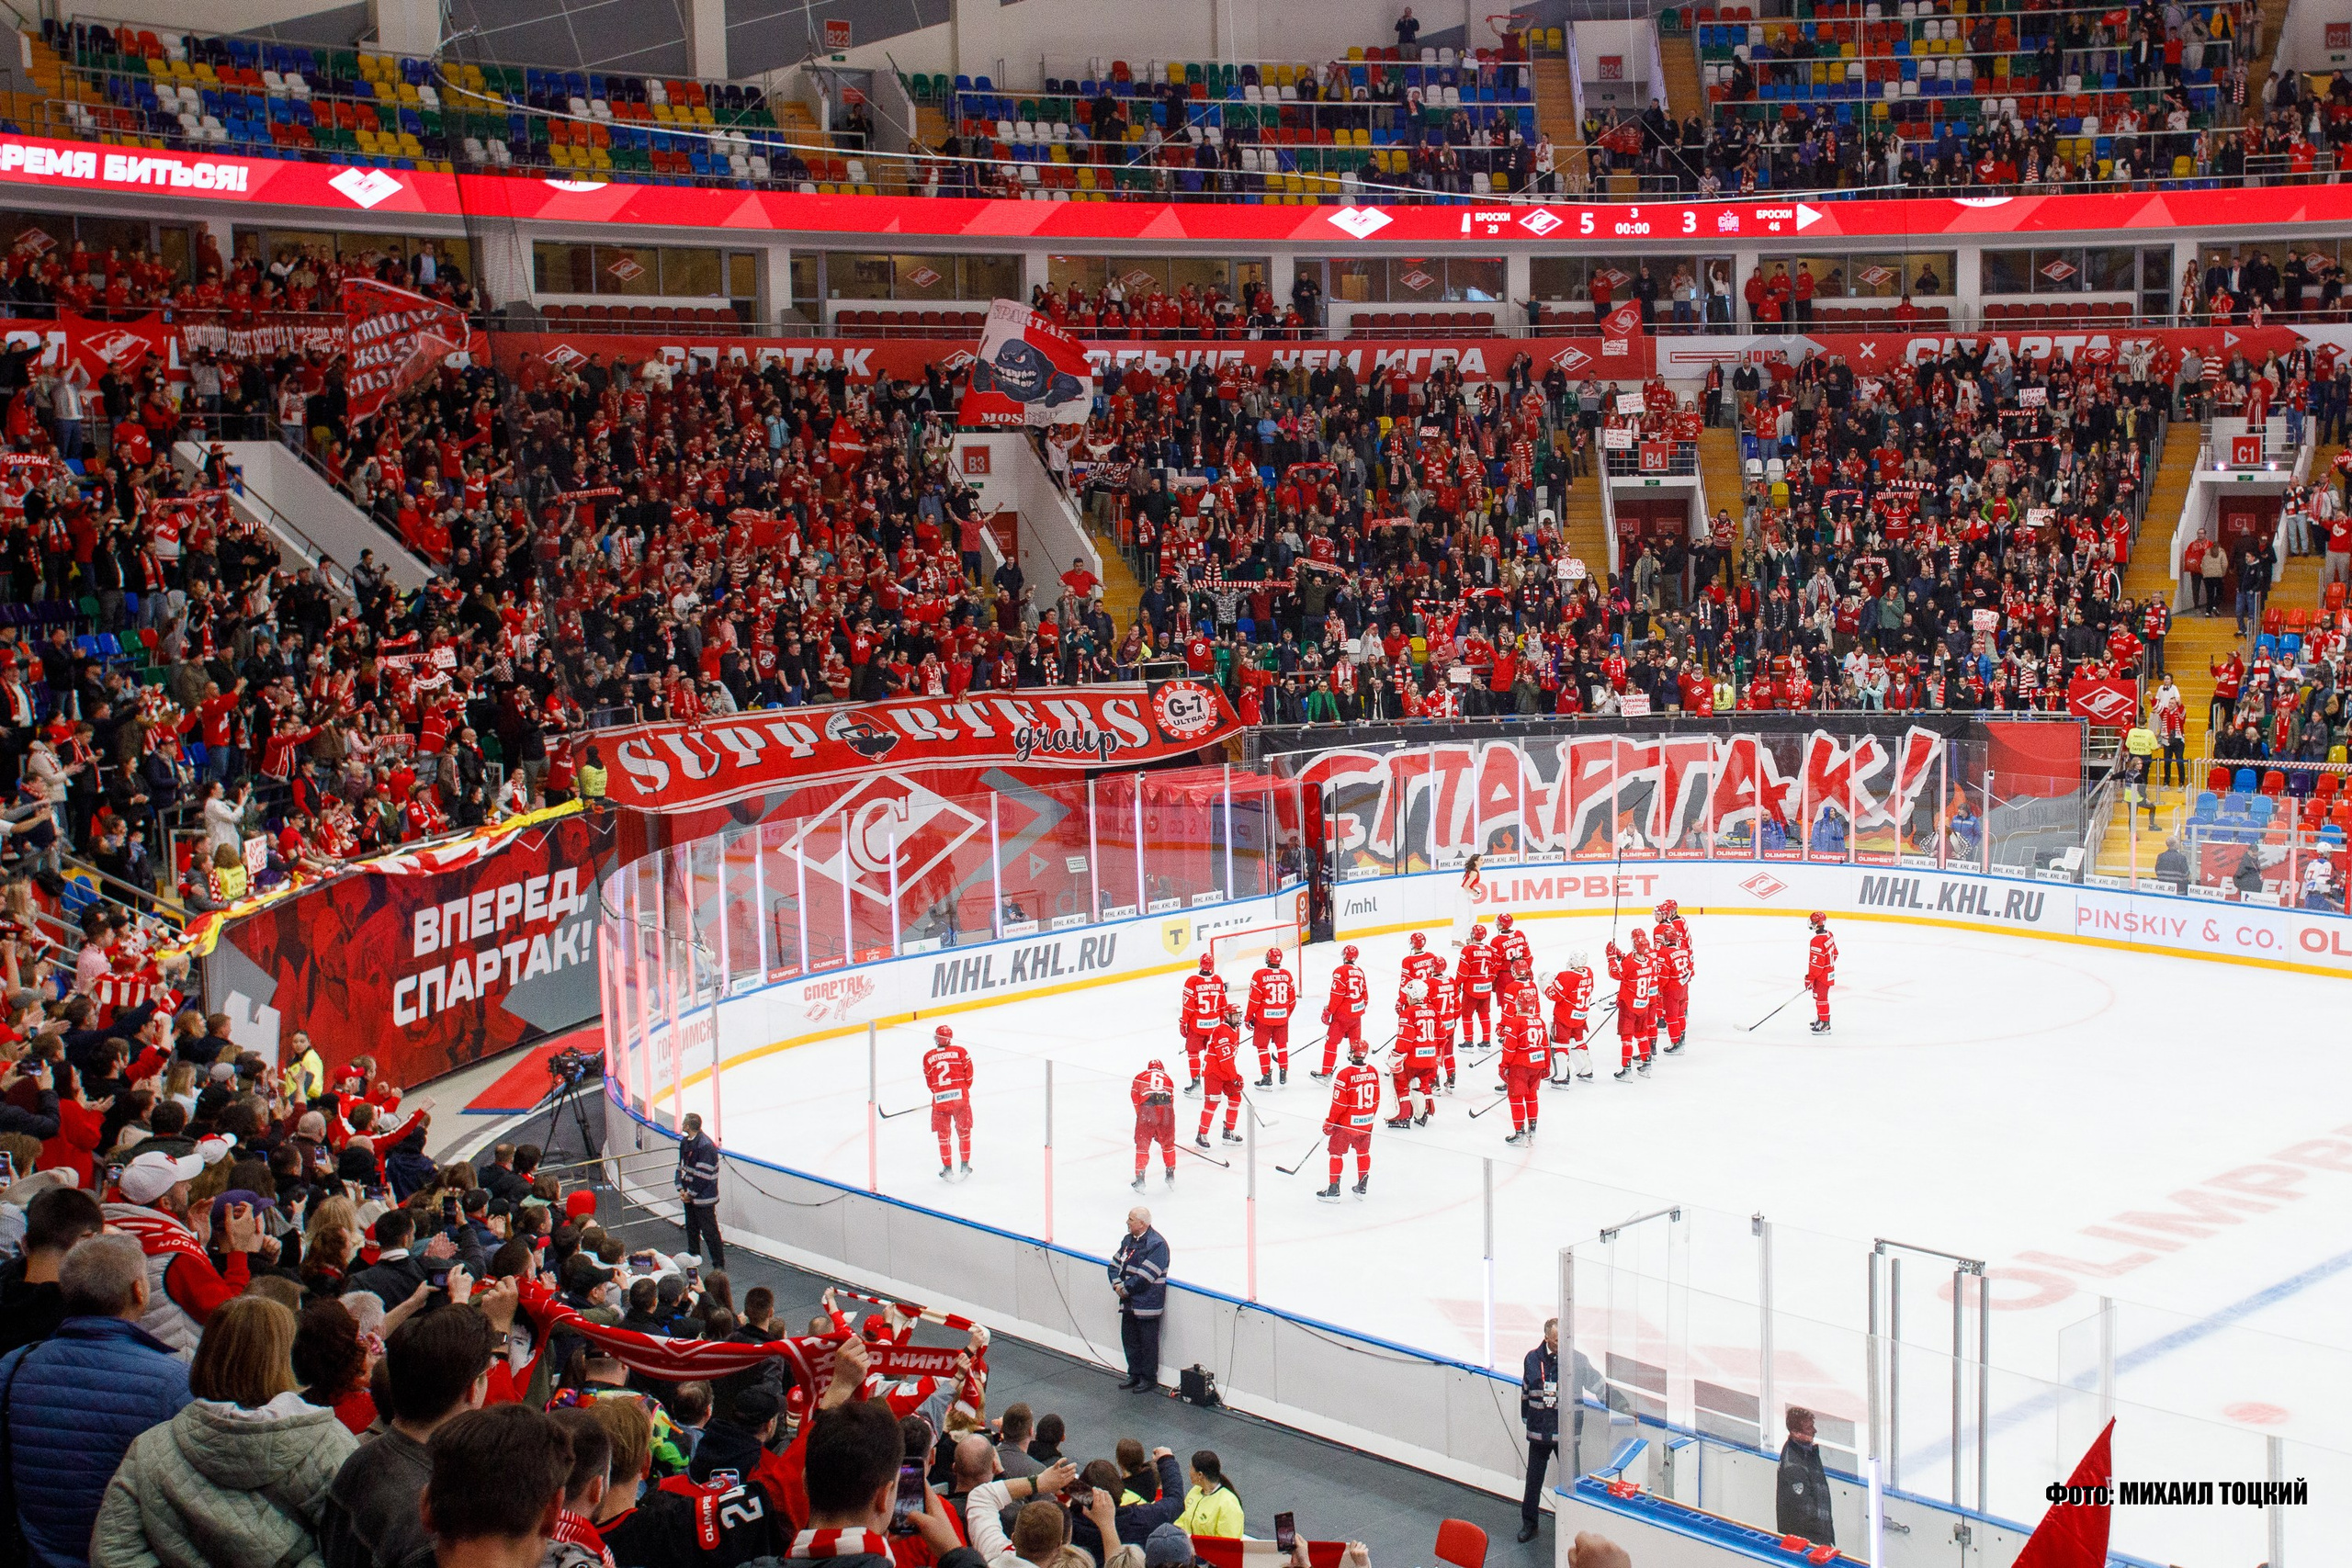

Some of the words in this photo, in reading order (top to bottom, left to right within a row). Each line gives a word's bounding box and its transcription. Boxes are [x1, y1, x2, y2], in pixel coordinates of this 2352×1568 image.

[0, 143, 96, 179] РЕМЯ
[103, 152, 249, 192] БИТЬСЯ!
[1475, 211, 1511, 222] БРОСКИ
[1630, 207, 1639, 219] 3
[1681, 210, 1698, 233] 3
[1756, 209, 1793, 220] БРОСКИ
[1487, 224, 1499, 234] 29
[1579, 212, 1596, 234] 5
[1614, 222, 1650, 235] 00:00
[1769, 221, 1781, 232] 46
[1374, 348, 1487, 375] ИГРА
[1645, 452, 1663, 468] B4
[2237, 446, 2255, 463] C1
[968, 456, 985, 472] B3
[1621, 523, 1634, 533] B4
[1168, 694, 1203, 717] G-7
[1013, 721, 1119, 762] group
[1295, 725, 1941, 856] СПАРТАК!
[411, 807, 421, 816] 12
[1576, 852, 1611, 860] OLIMPBET
[1620, 851, 1657, 859] OLIMPBET
[1668, 850, 1704, 858] OLIMPBET
[1716, 849, 1754, 858] OLIMPBET
[1765, 851, 1802, 860] OLIMPBET
[1810, 852, 1847, 862] OLIMPBET
[1858, 853, 1894, 863] OLIMPBET
[1344, 897, 1378, 917] /mhl
[1859, 874, 2045, 922] MHL.KHL.RU
[413, 865, 588, 958] ВПЕРЕД,
[1006, 922, 1036, 934] SPARTAK.RU
[2077, 906, 2188, 938] PINSKIY
[2201, 918, 2221, 942] &
[2235, 926, 2283, 951] CO.
[813, 957, 844, 969] OLIMPBET
[931, 932, 1118, 998] MHL.KHL.RU
[1479, 958, 1489, 978] 4
[392, 919, 592, 1028] СПАРТАК!
[770, 967, 799, 980] OLIMPBET
[804, 975, 865, 1002] СПАРТАК
[1264, 983, 1288, 1005] 38
[1197, 991, 1220, 1014] 57
[1436, 993, 1455, 1015] 75
[1416, 1019, 1435, 1043] 30
[1221, 1046, 1231, 1057] 53
[936, 1060, 952, 1087] 2
[1149, 1072, 1164, 1090] 6
[1355, 1082, 1374, 1110] 19
[157, 1239, 208, 1258] МОСКВ
[888, 1351, 958, 1371] МИНУ
